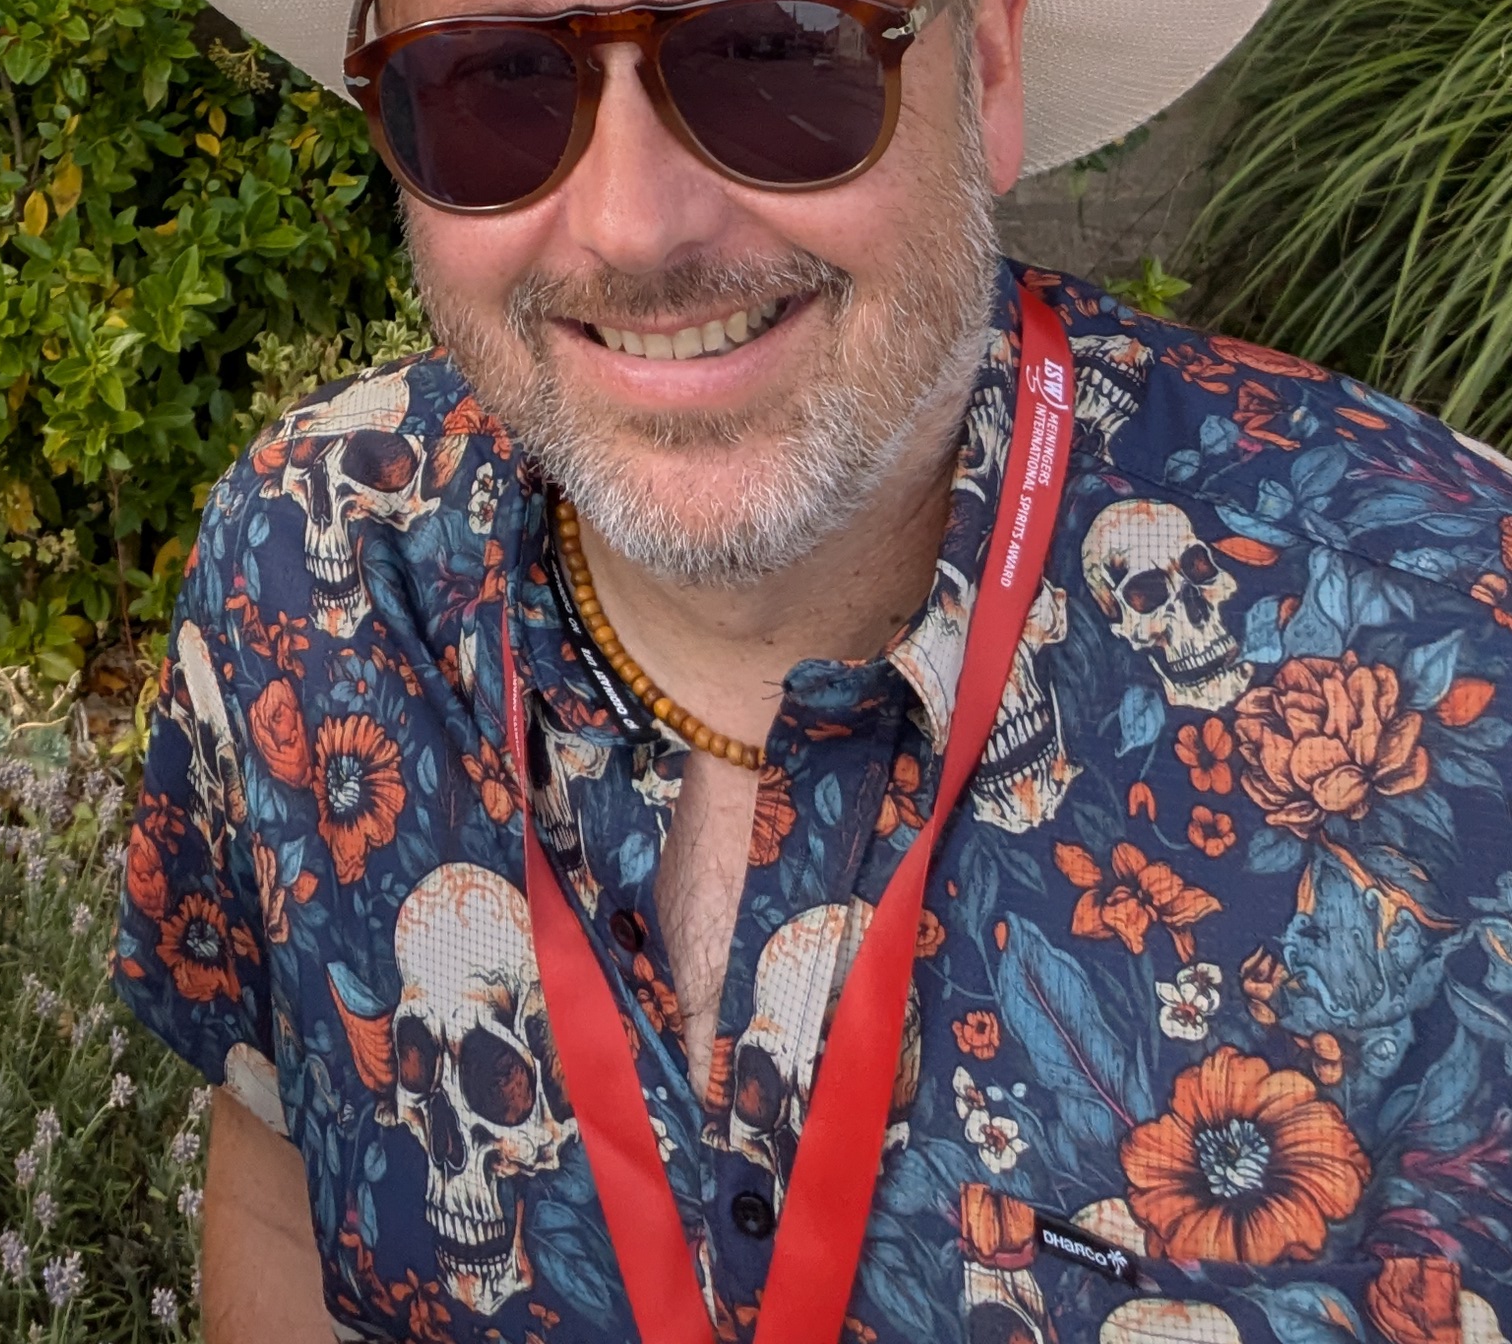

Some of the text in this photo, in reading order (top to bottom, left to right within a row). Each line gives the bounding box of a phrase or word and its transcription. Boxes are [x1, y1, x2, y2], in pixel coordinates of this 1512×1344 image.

[1043, 357, 1064, 403] ISW
[1037, 411, 1059, 487] MEININGERS
[1000, 402, 1047, 588] INTERNATIONAL SPIRITS AWARD
